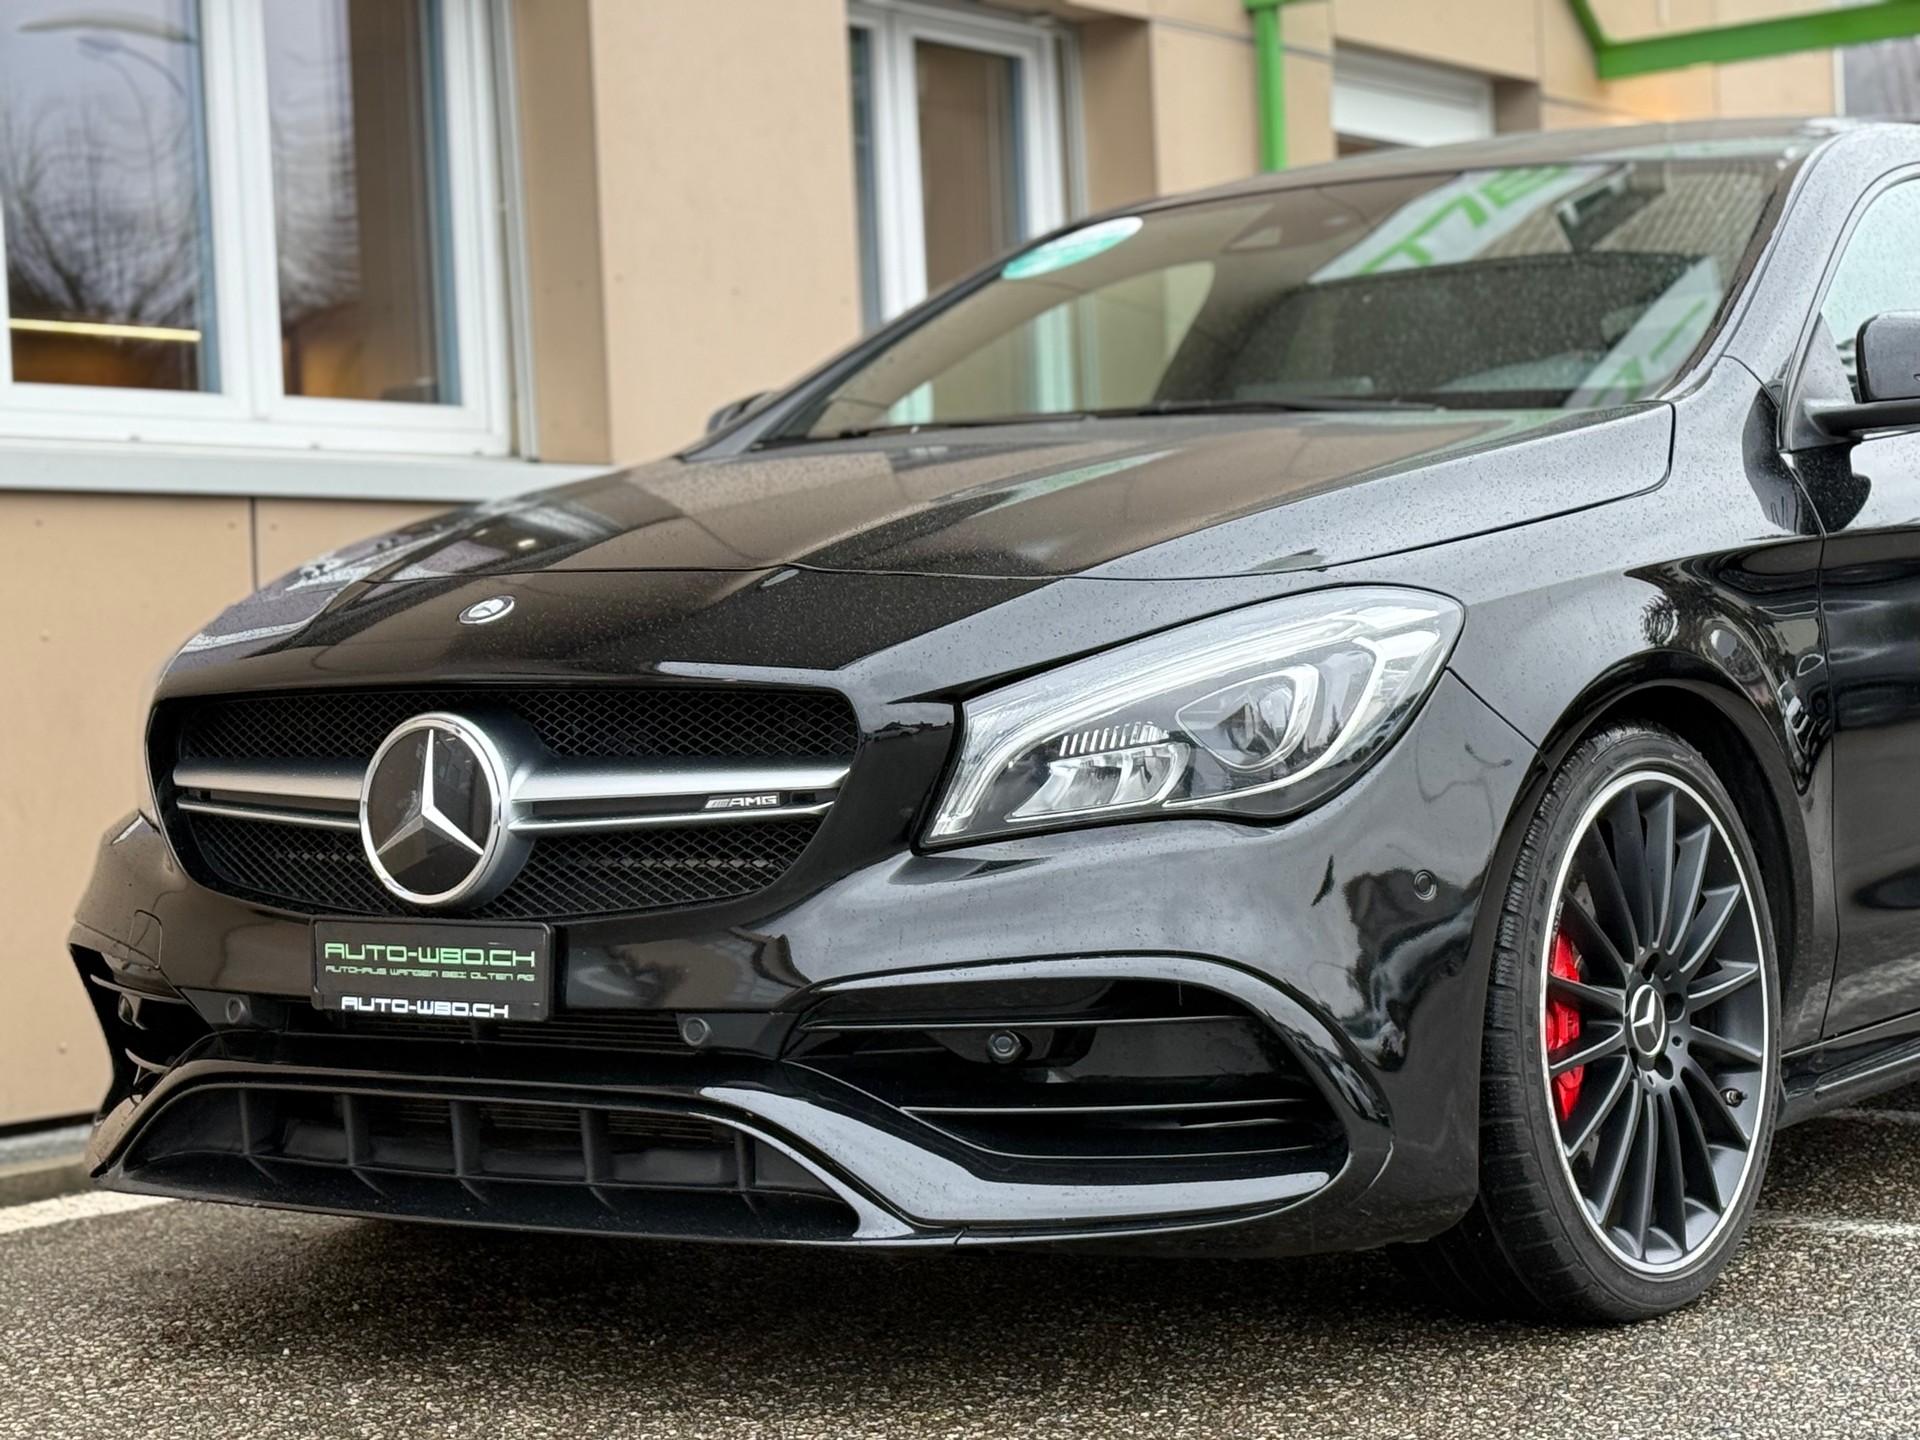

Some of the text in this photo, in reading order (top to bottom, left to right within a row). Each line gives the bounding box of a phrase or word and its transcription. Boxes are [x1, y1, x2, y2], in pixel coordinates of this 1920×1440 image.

[728, 795, 777, 808] AMG
[324, 942, 536, 968] AUTO-WBO.CH
[325, 965, 535, 982] AUTOHAUS WANGEN BEI OLTEN AG
[341, 995, 509, 1019] AUTO-WBO.CH
